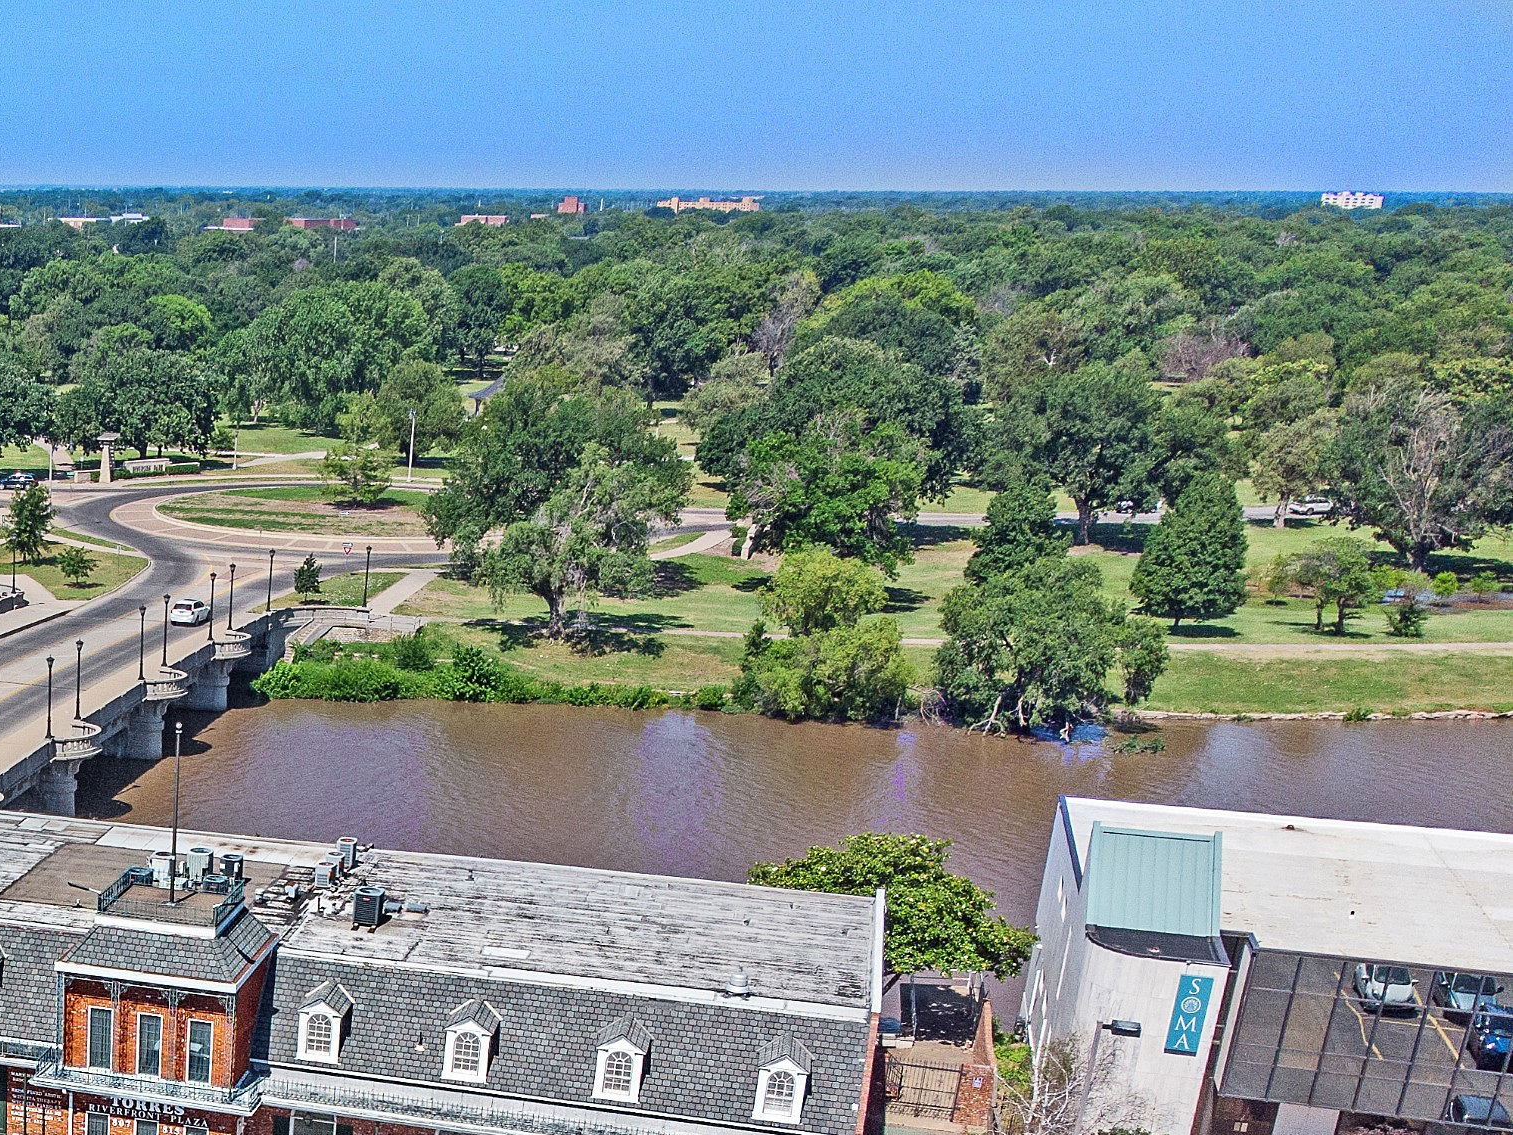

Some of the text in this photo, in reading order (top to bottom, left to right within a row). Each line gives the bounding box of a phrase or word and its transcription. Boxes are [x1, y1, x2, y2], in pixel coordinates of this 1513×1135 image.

[1173, 978, 1201, 1050] SOMA
[88, 1103, 208, 1127] RIVERFRONT PLAZA
[110, 1097, 185, 1116] TORRES
